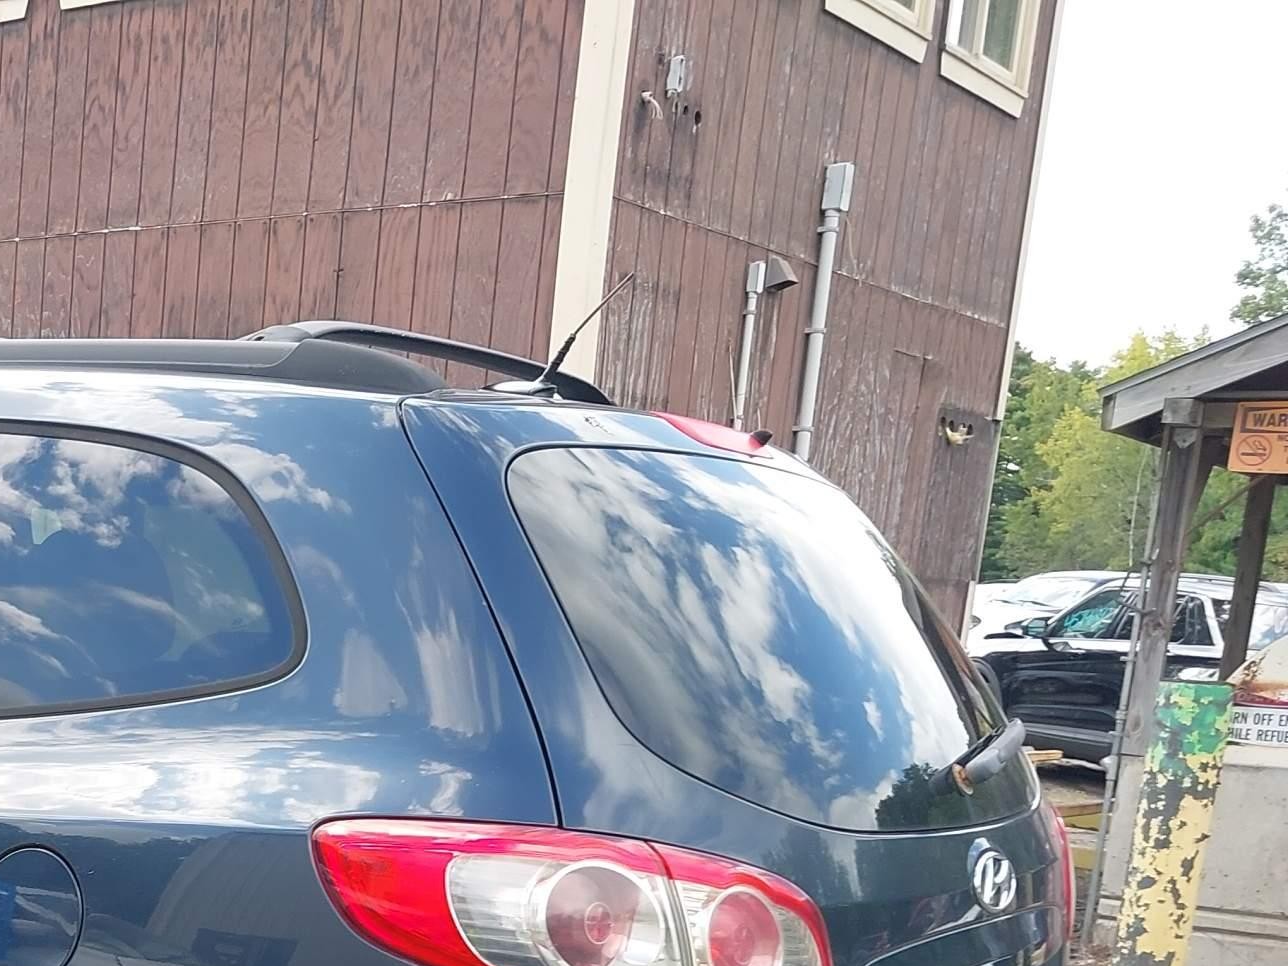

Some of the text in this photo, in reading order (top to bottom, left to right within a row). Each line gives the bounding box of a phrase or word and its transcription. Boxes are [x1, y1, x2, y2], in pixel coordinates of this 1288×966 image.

[1230, 711, 1249, 725] RN
[1253, 712, 1274, 726] OFF
[1227, 727, 1252, 740] HILE
